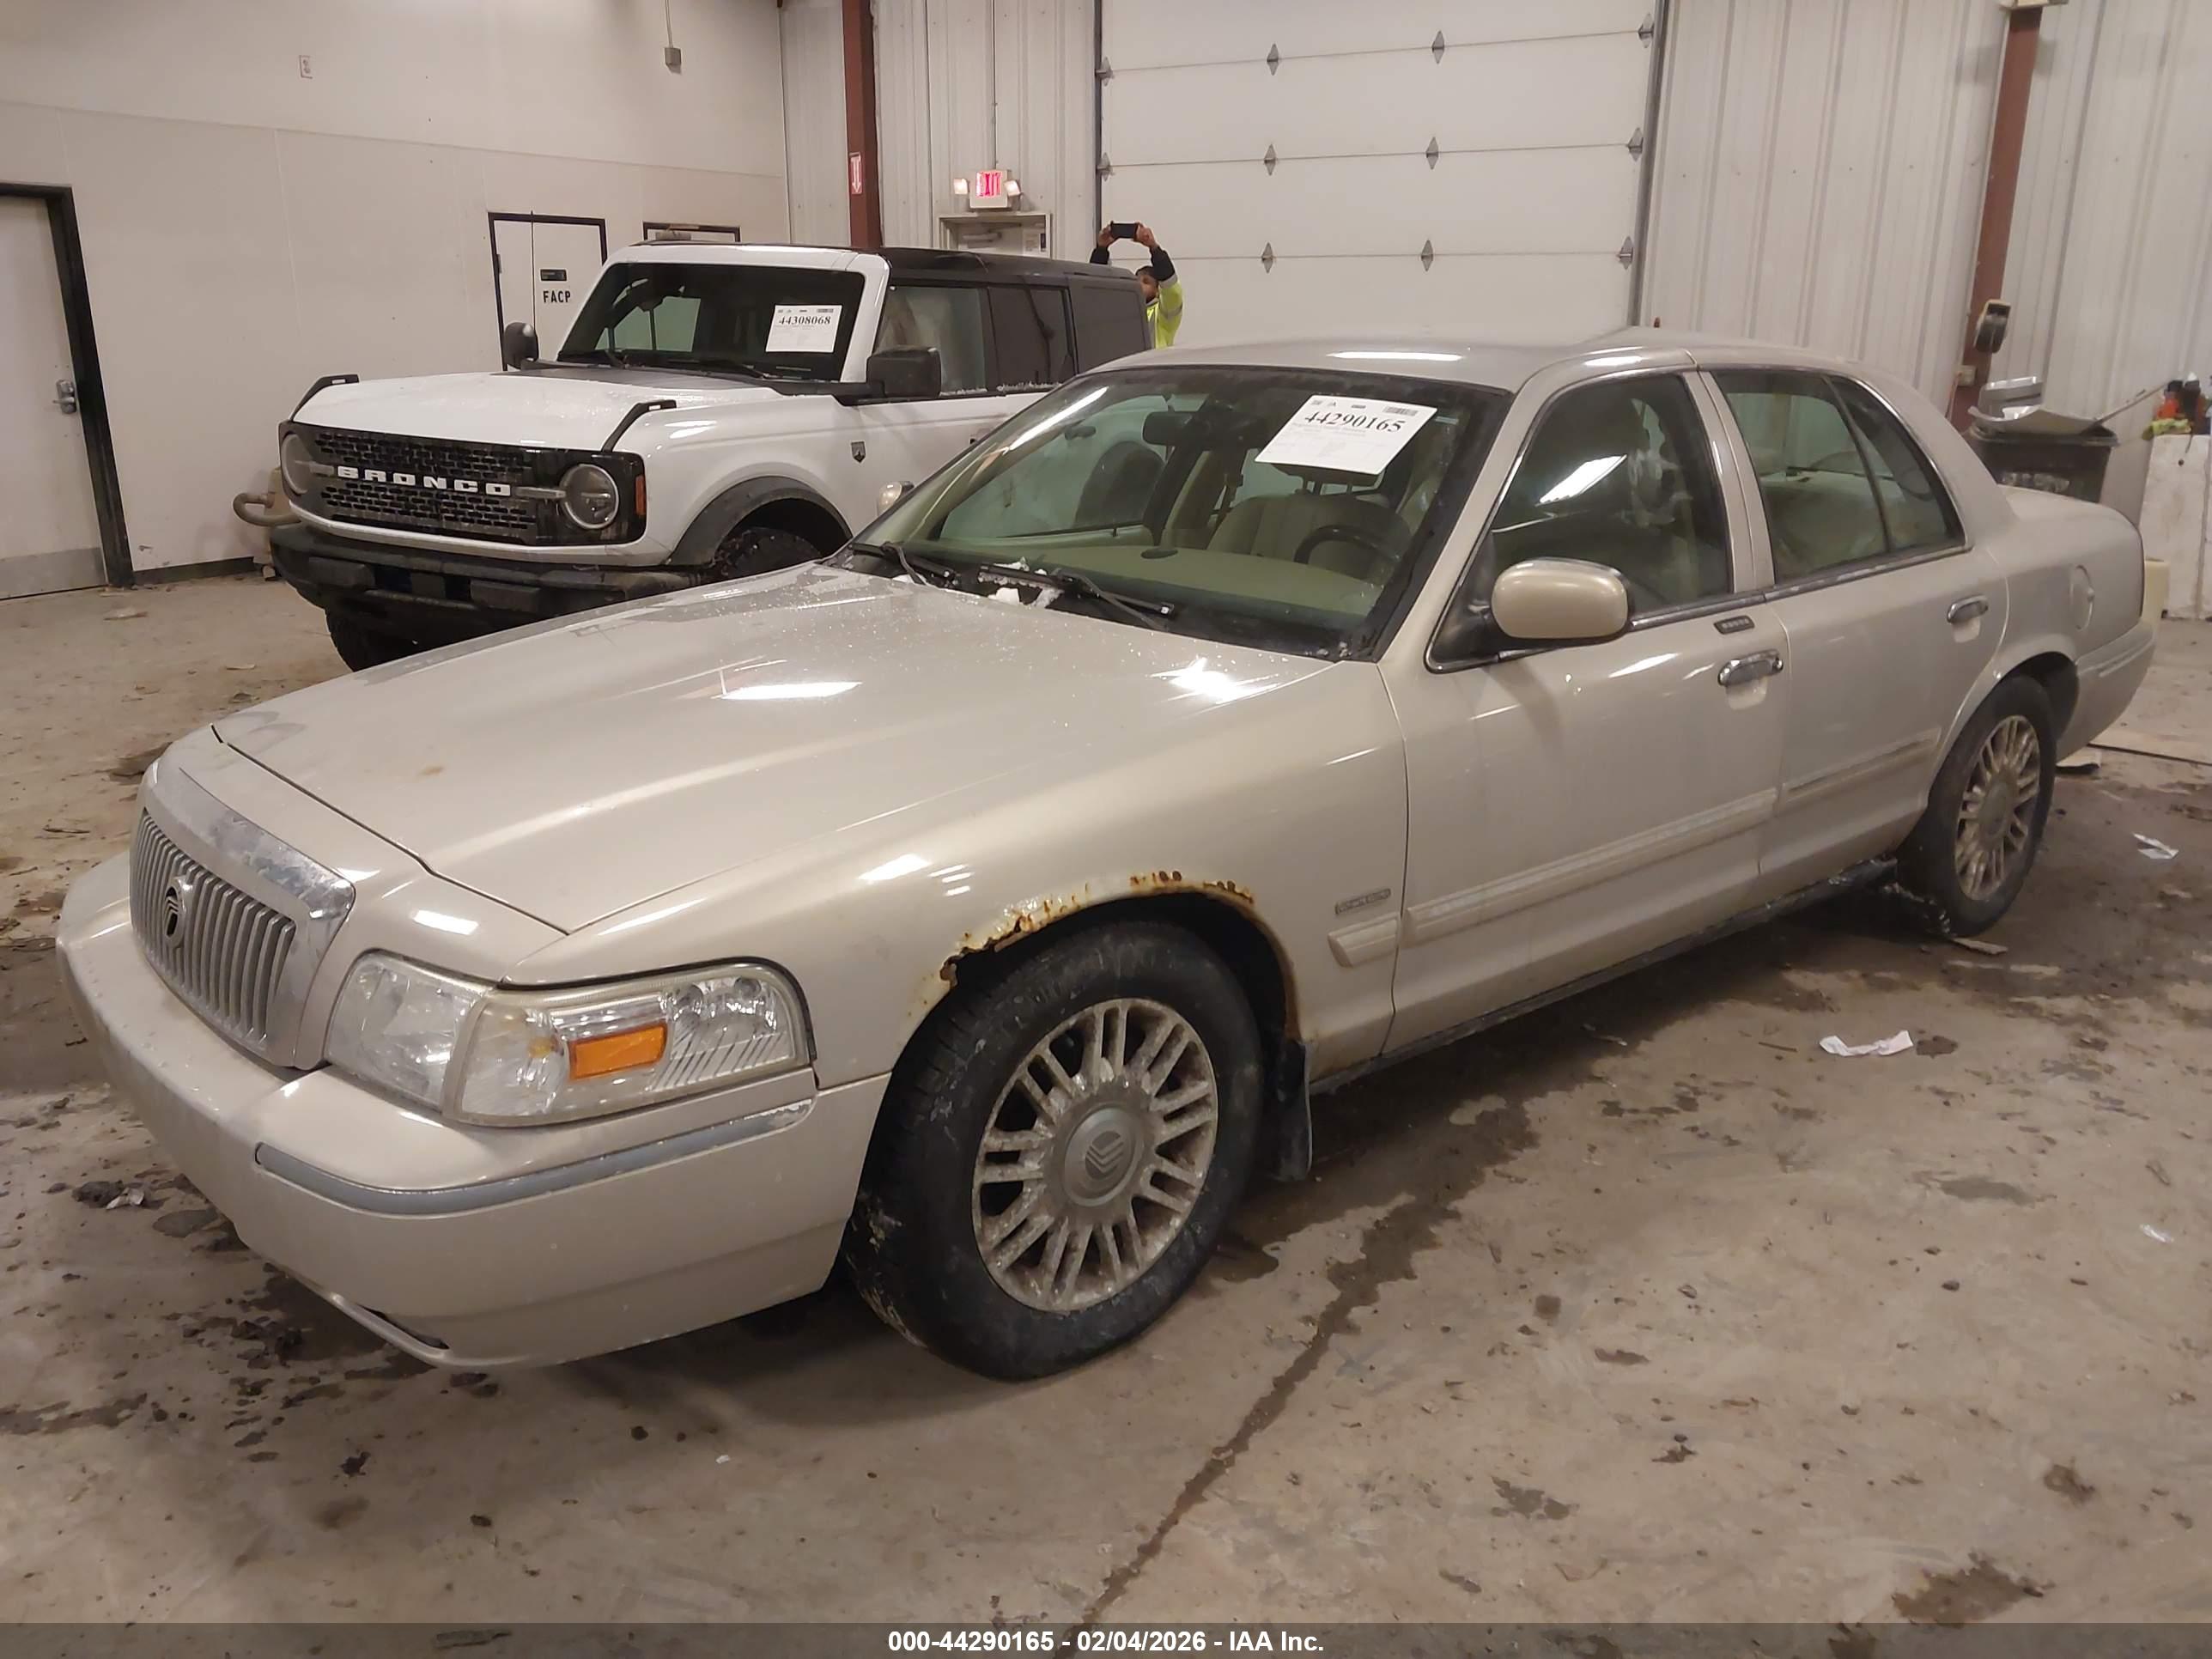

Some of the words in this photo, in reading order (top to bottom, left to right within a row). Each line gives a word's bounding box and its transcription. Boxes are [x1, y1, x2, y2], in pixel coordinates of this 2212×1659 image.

[975, 172, 1001, 197] EXIT
[543, 290, 571, 303] FACP
[779, 315, 831, 325] 44308068
[1304, 410, 1407, 433] 44290165
[337, 465, 511, 496] BRONCO
